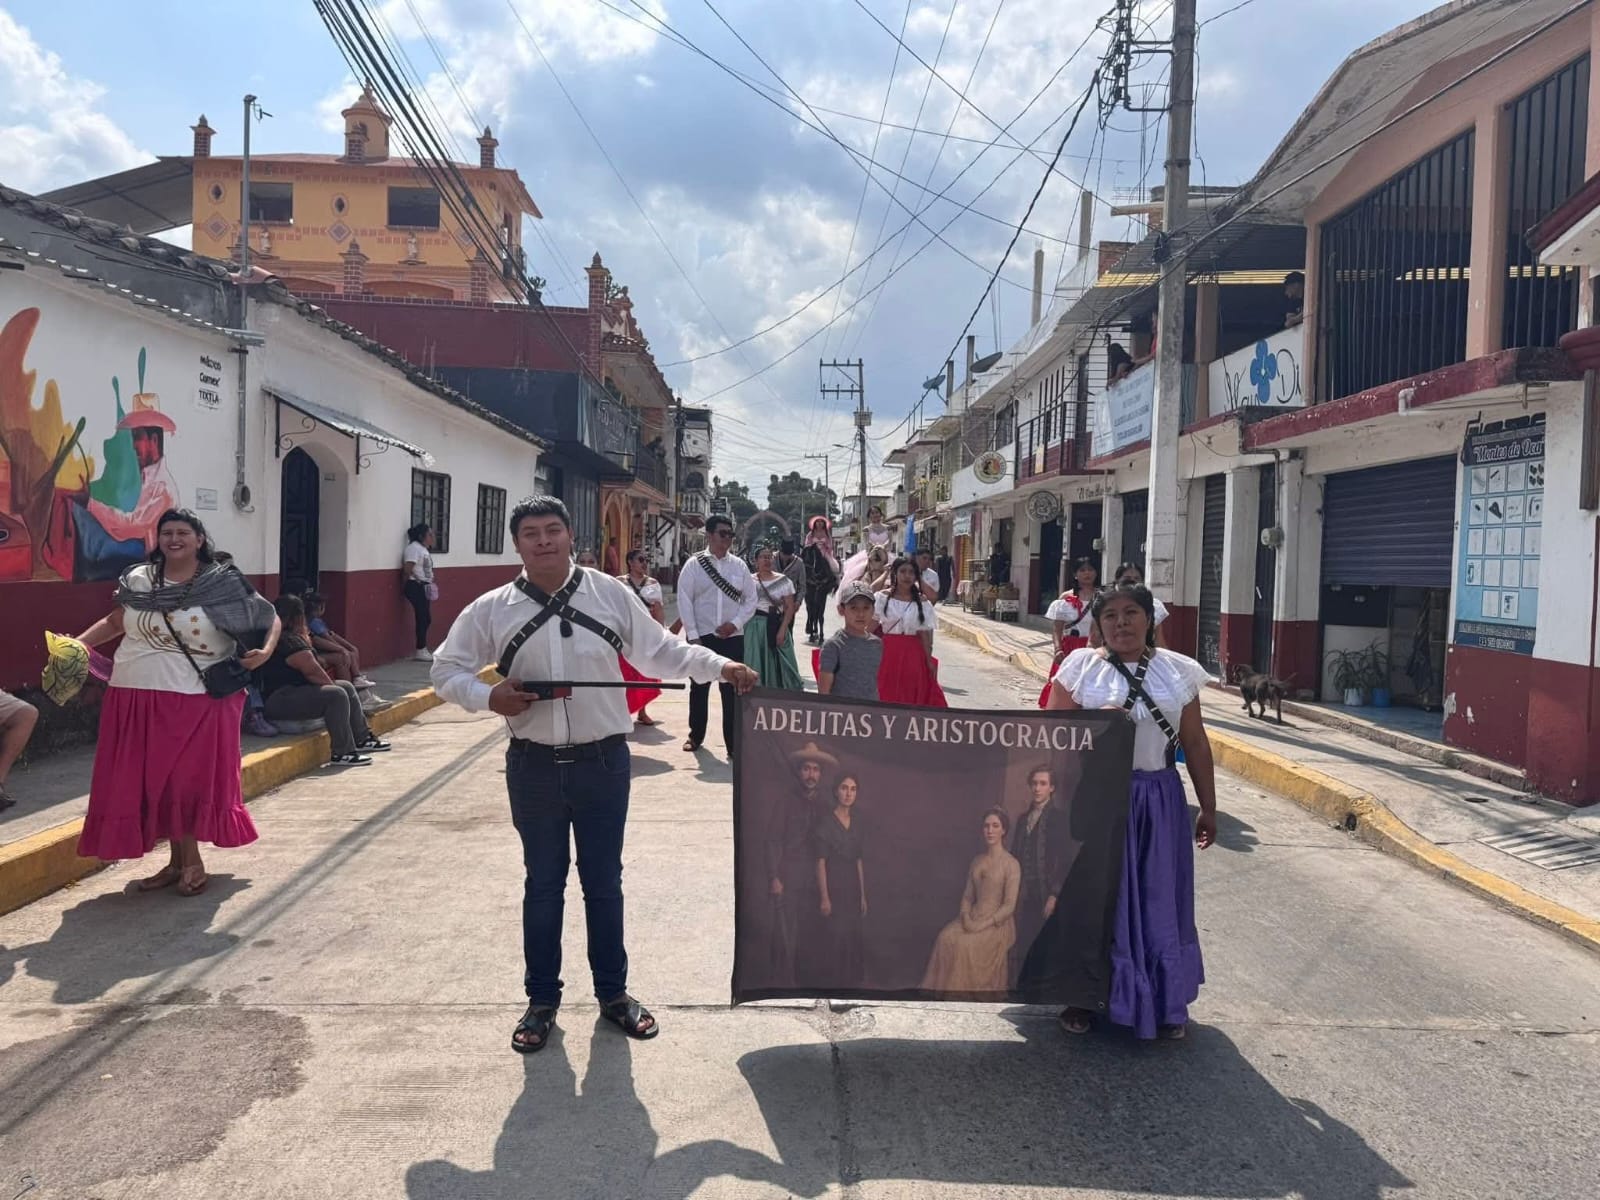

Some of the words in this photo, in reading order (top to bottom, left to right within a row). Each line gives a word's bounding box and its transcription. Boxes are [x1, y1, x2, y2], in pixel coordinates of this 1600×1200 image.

[1508, 441, 1521, 458] de
[753, 706, 873, 738] ADELITAS
[881, 714, 897, 740] Y
[904, 716, 1095, 752] ARISTOCRACIA
